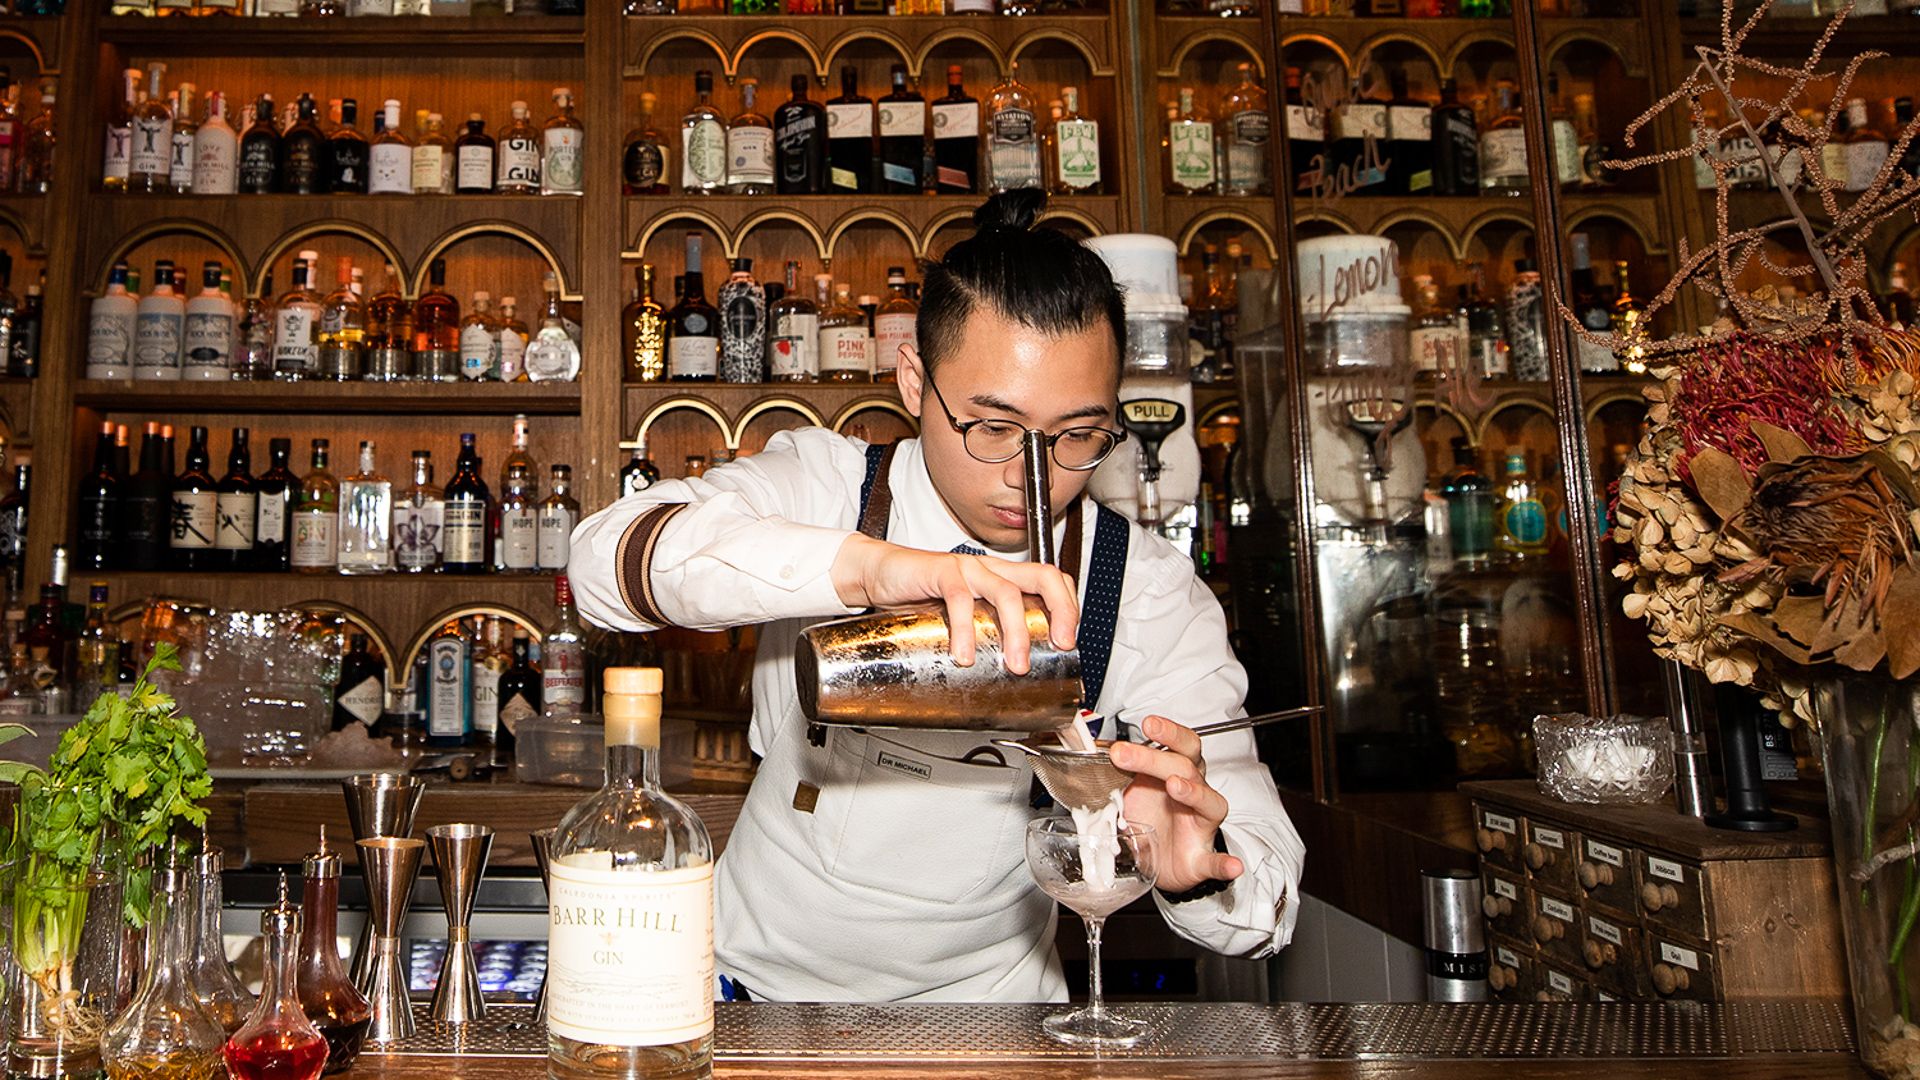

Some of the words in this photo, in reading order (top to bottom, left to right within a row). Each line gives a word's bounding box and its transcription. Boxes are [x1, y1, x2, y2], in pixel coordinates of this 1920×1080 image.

[837, 340, 864, 351] PINK
[1134, 405, 1169, 417] PULL
[513, 518, 533, 528] HOPE
[545, 678, 583, 688] BEEFEATER
[894, 761, 928, 777] MICHAEL
[554, 905, 605, 926] BARR
[617, 907, 682, 933] HILL
[593, 950, 625, 965] GIN
